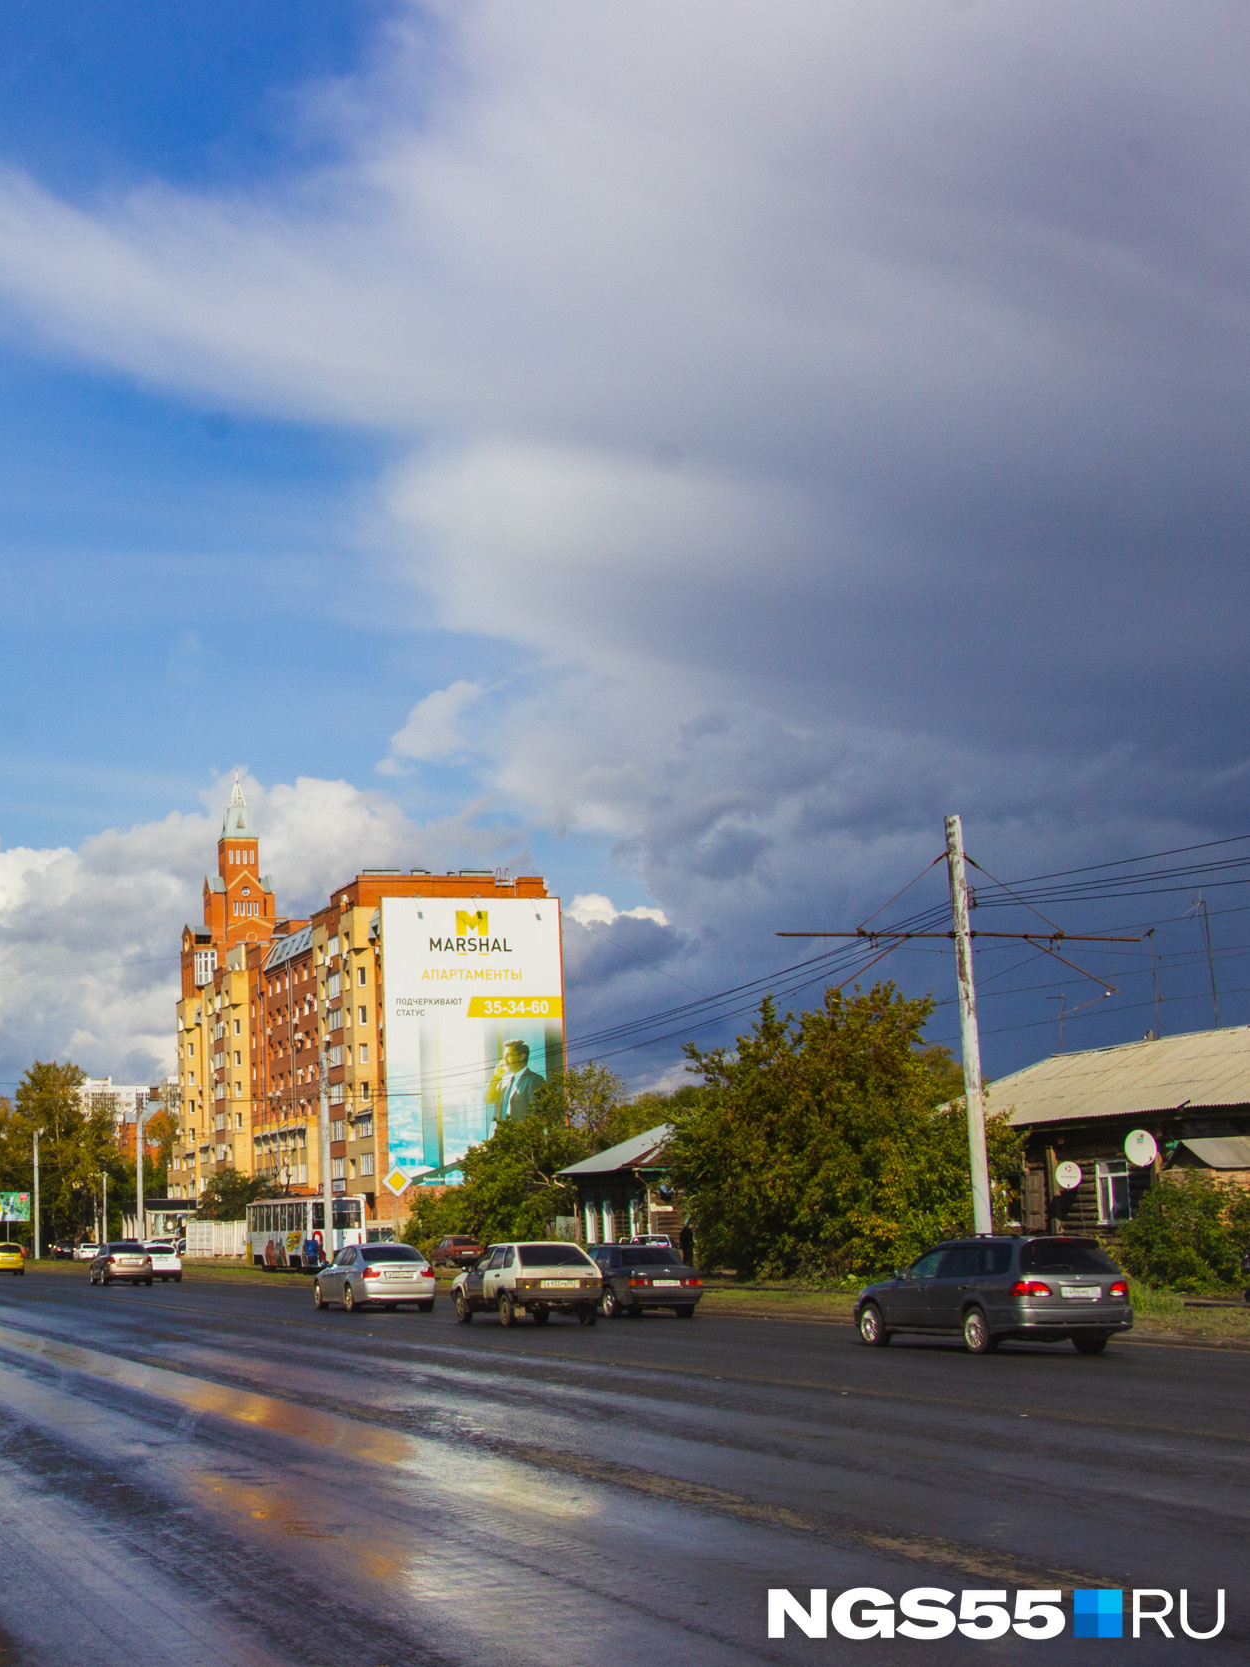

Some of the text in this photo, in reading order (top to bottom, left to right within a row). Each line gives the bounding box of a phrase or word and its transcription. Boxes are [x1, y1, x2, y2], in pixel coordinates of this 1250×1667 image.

[429, 937, 513, 952] MARSHAL
[421, 969, 523, 981] АПАРТАМЕНТЫ
[396, 997, 463, 1007] ПОДЧЕРКИВАЮТ
[484, 1000, 549, 1014] 35-34-60
[396, 1009, 426, 1017] СТАТУС
